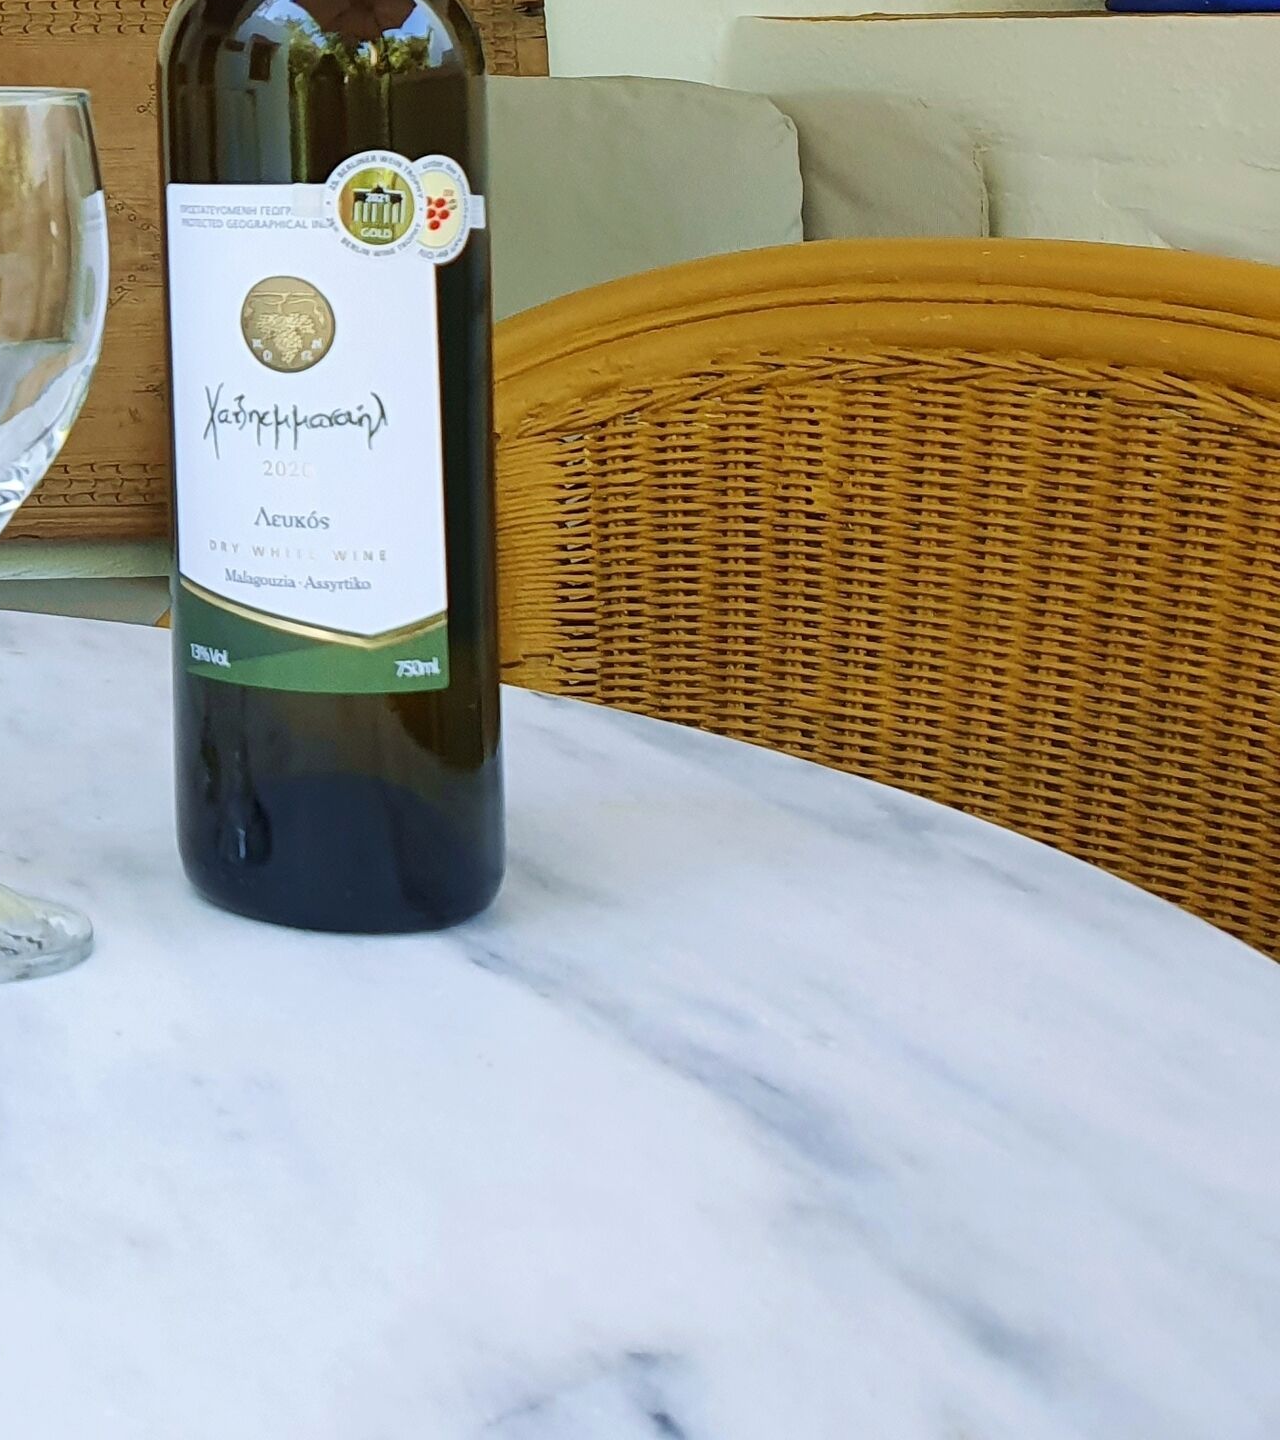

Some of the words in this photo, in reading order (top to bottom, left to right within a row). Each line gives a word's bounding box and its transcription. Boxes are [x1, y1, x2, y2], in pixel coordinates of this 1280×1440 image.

[227, 219, 308, 229] GEOGRAPHICAL
[361, 227, 393, 238] GOLD
[254, 506, 331, 530] Λευκός
[209, 539, 240, 554] DRY
[252, 545, 317, 560] WHITE
[332, 550, 388, 561] WINE
[224, 568, 296, 588] Malagouzia
[304, 576, 372, 593] Assyrtiko
